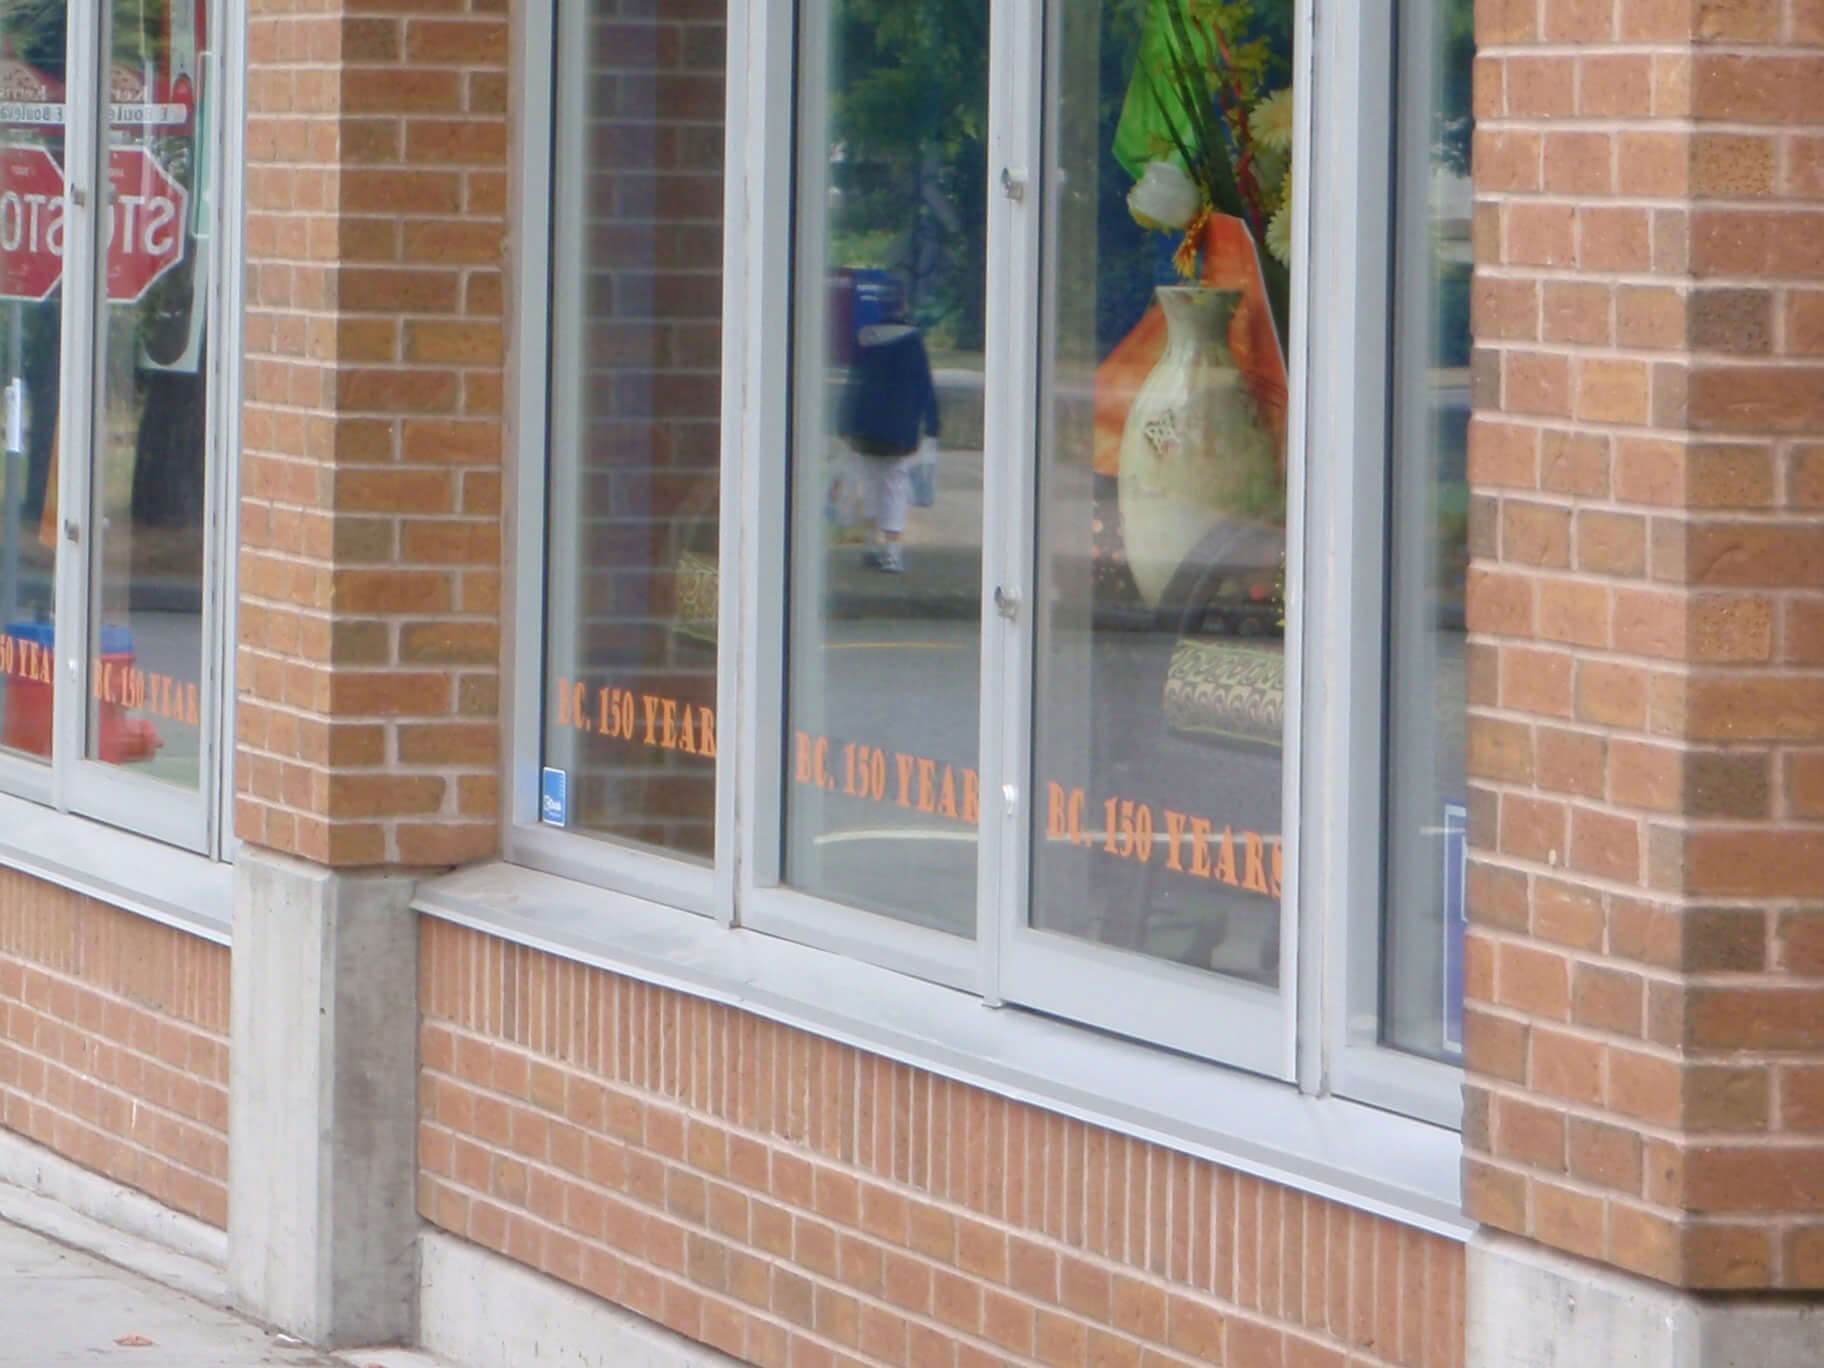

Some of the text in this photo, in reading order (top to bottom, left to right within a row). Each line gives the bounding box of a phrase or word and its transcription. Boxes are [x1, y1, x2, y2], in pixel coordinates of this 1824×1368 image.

[599, 687, 635, 741] 150
[844, 741, 887, 802] 150
[1103, 796, 1154, 863] 150
